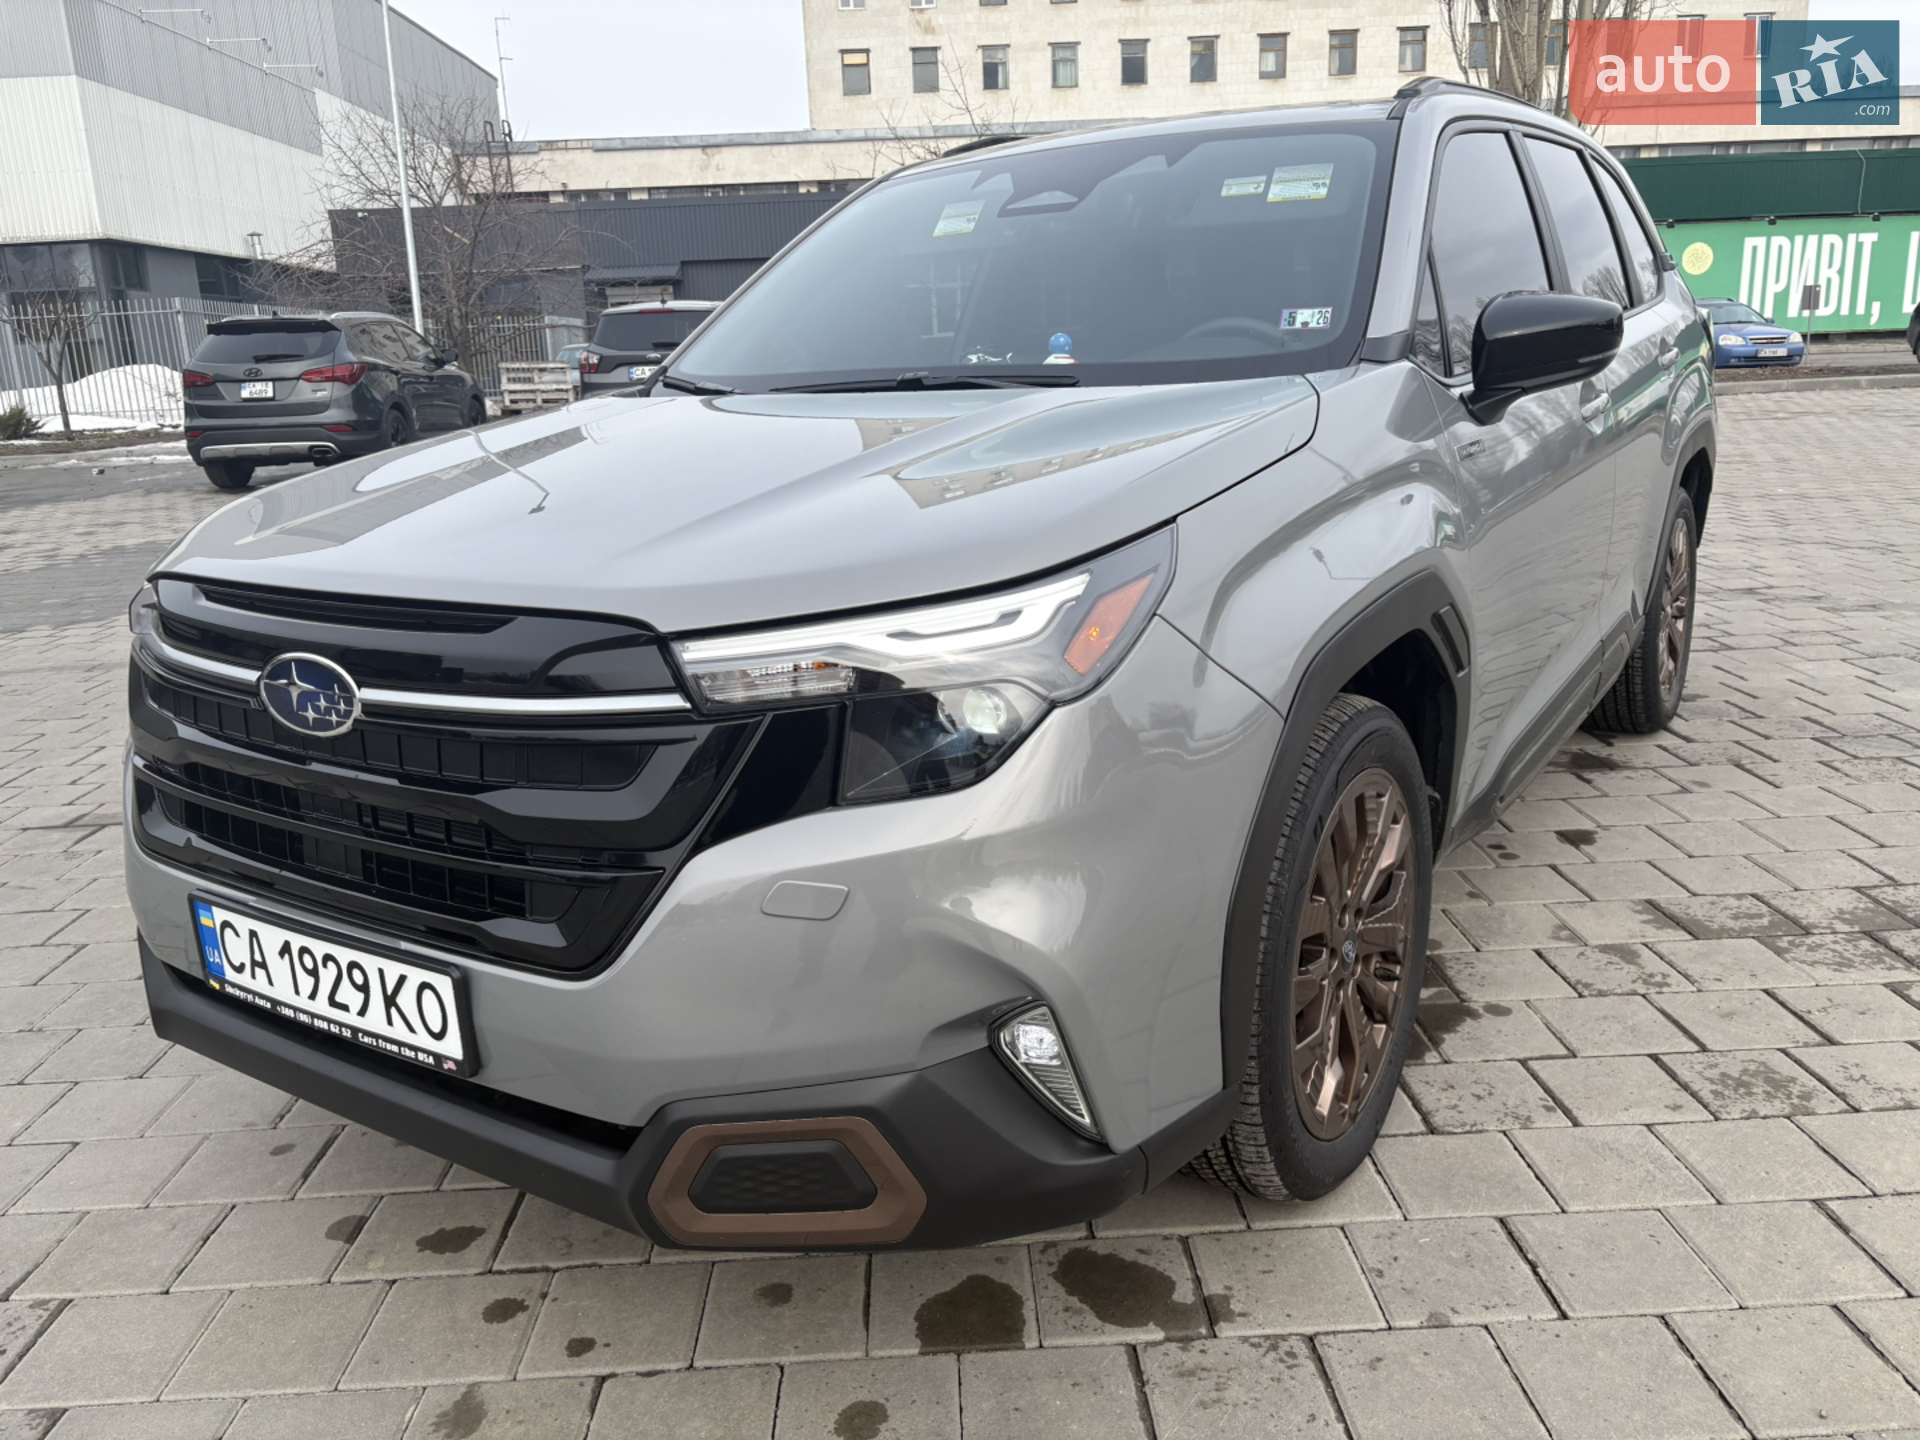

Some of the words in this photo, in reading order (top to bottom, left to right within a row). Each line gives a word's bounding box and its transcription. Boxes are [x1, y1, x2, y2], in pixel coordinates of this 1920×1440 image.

[1738, 232, 1881, 326] ПРИВІТ,
[1287, 311, 1297, 327] 5
[1316, 310, 1330, 325] 26
[205, 945, 221, 965] UA
[219, 919, 275, 988] CA
[278, 939, 371, 1018] 1929
[377, 967, 449, 1041] KO
[358, 1032, 377, 1047] Cars
[378, 1038, 400, 1053] from
[400, 1045, 416, 1058] the
[417, 1051, 436, 1066] USA
